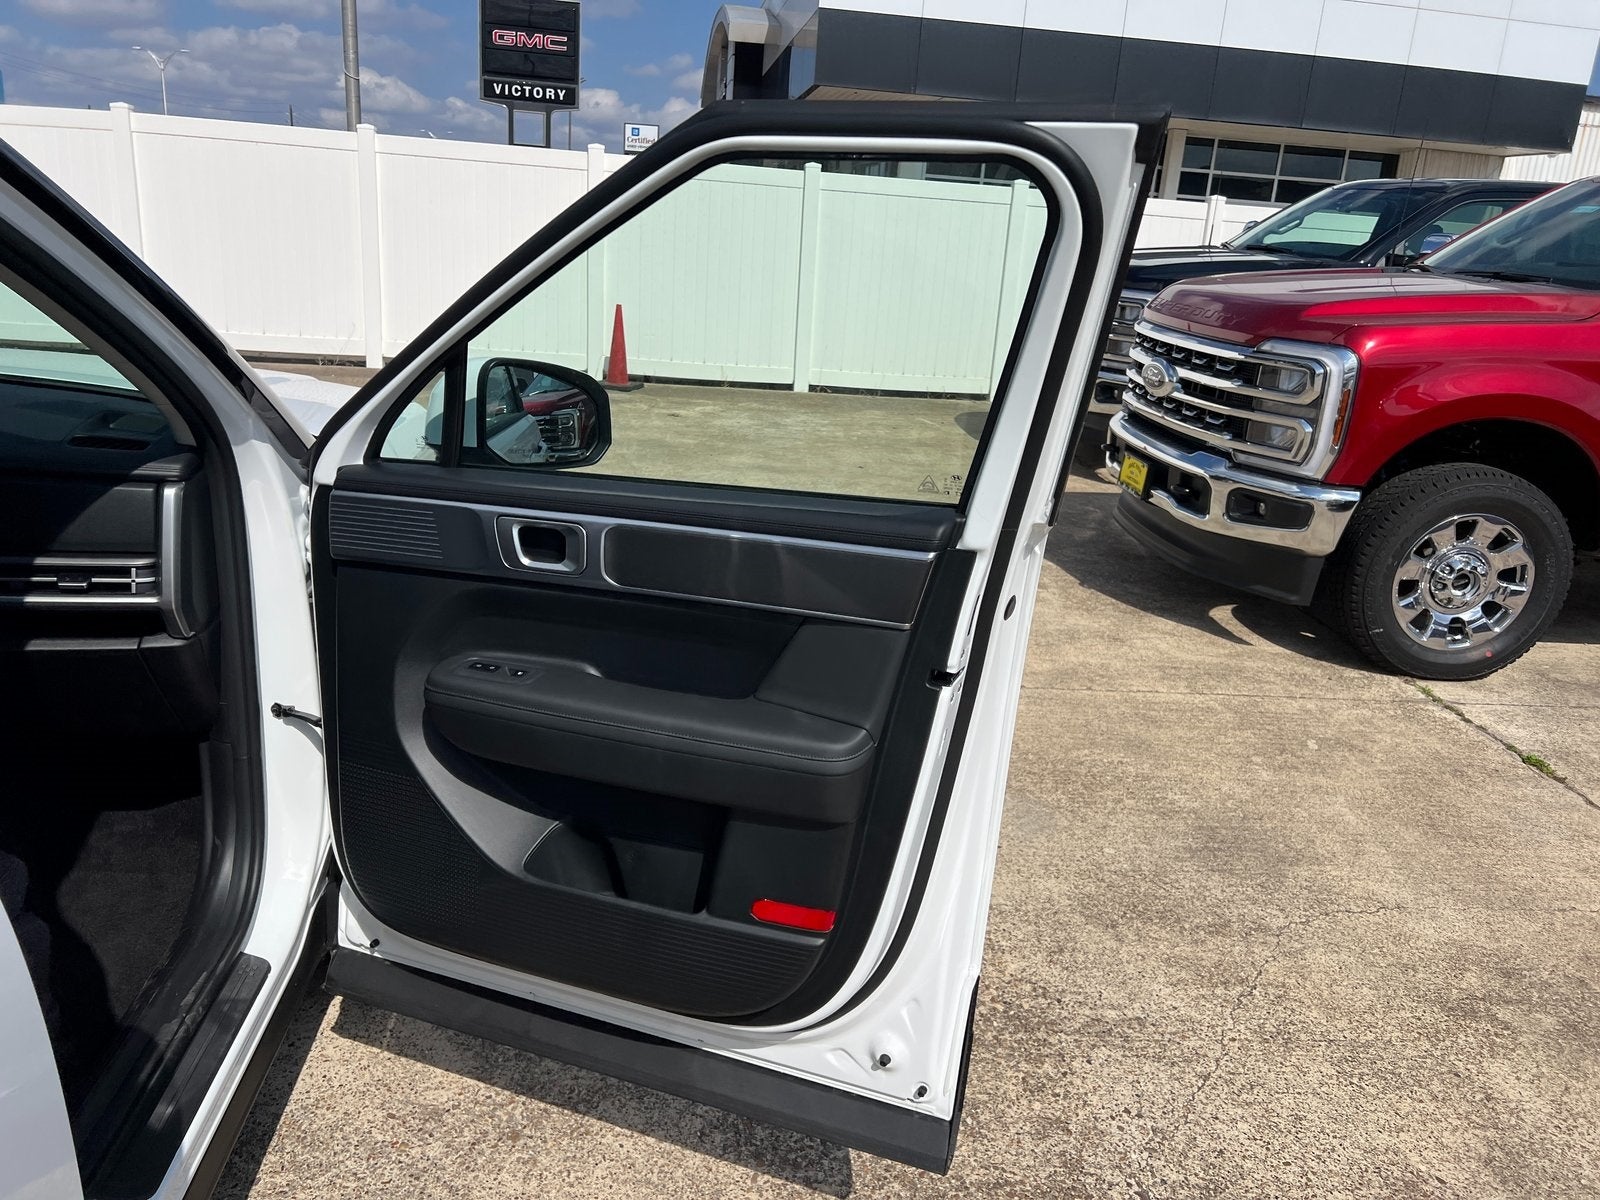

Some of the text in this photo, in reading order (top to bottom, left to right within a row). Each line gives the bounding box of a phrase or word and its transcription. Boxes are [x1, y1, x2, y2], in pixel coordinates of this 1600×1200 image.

[492, 29, 568, 51] GMC
[493, 82, 566, 101] VICTORY
[627, 136, 656, 144] Certified
[1191, 306, 1245, 325] DUTY
